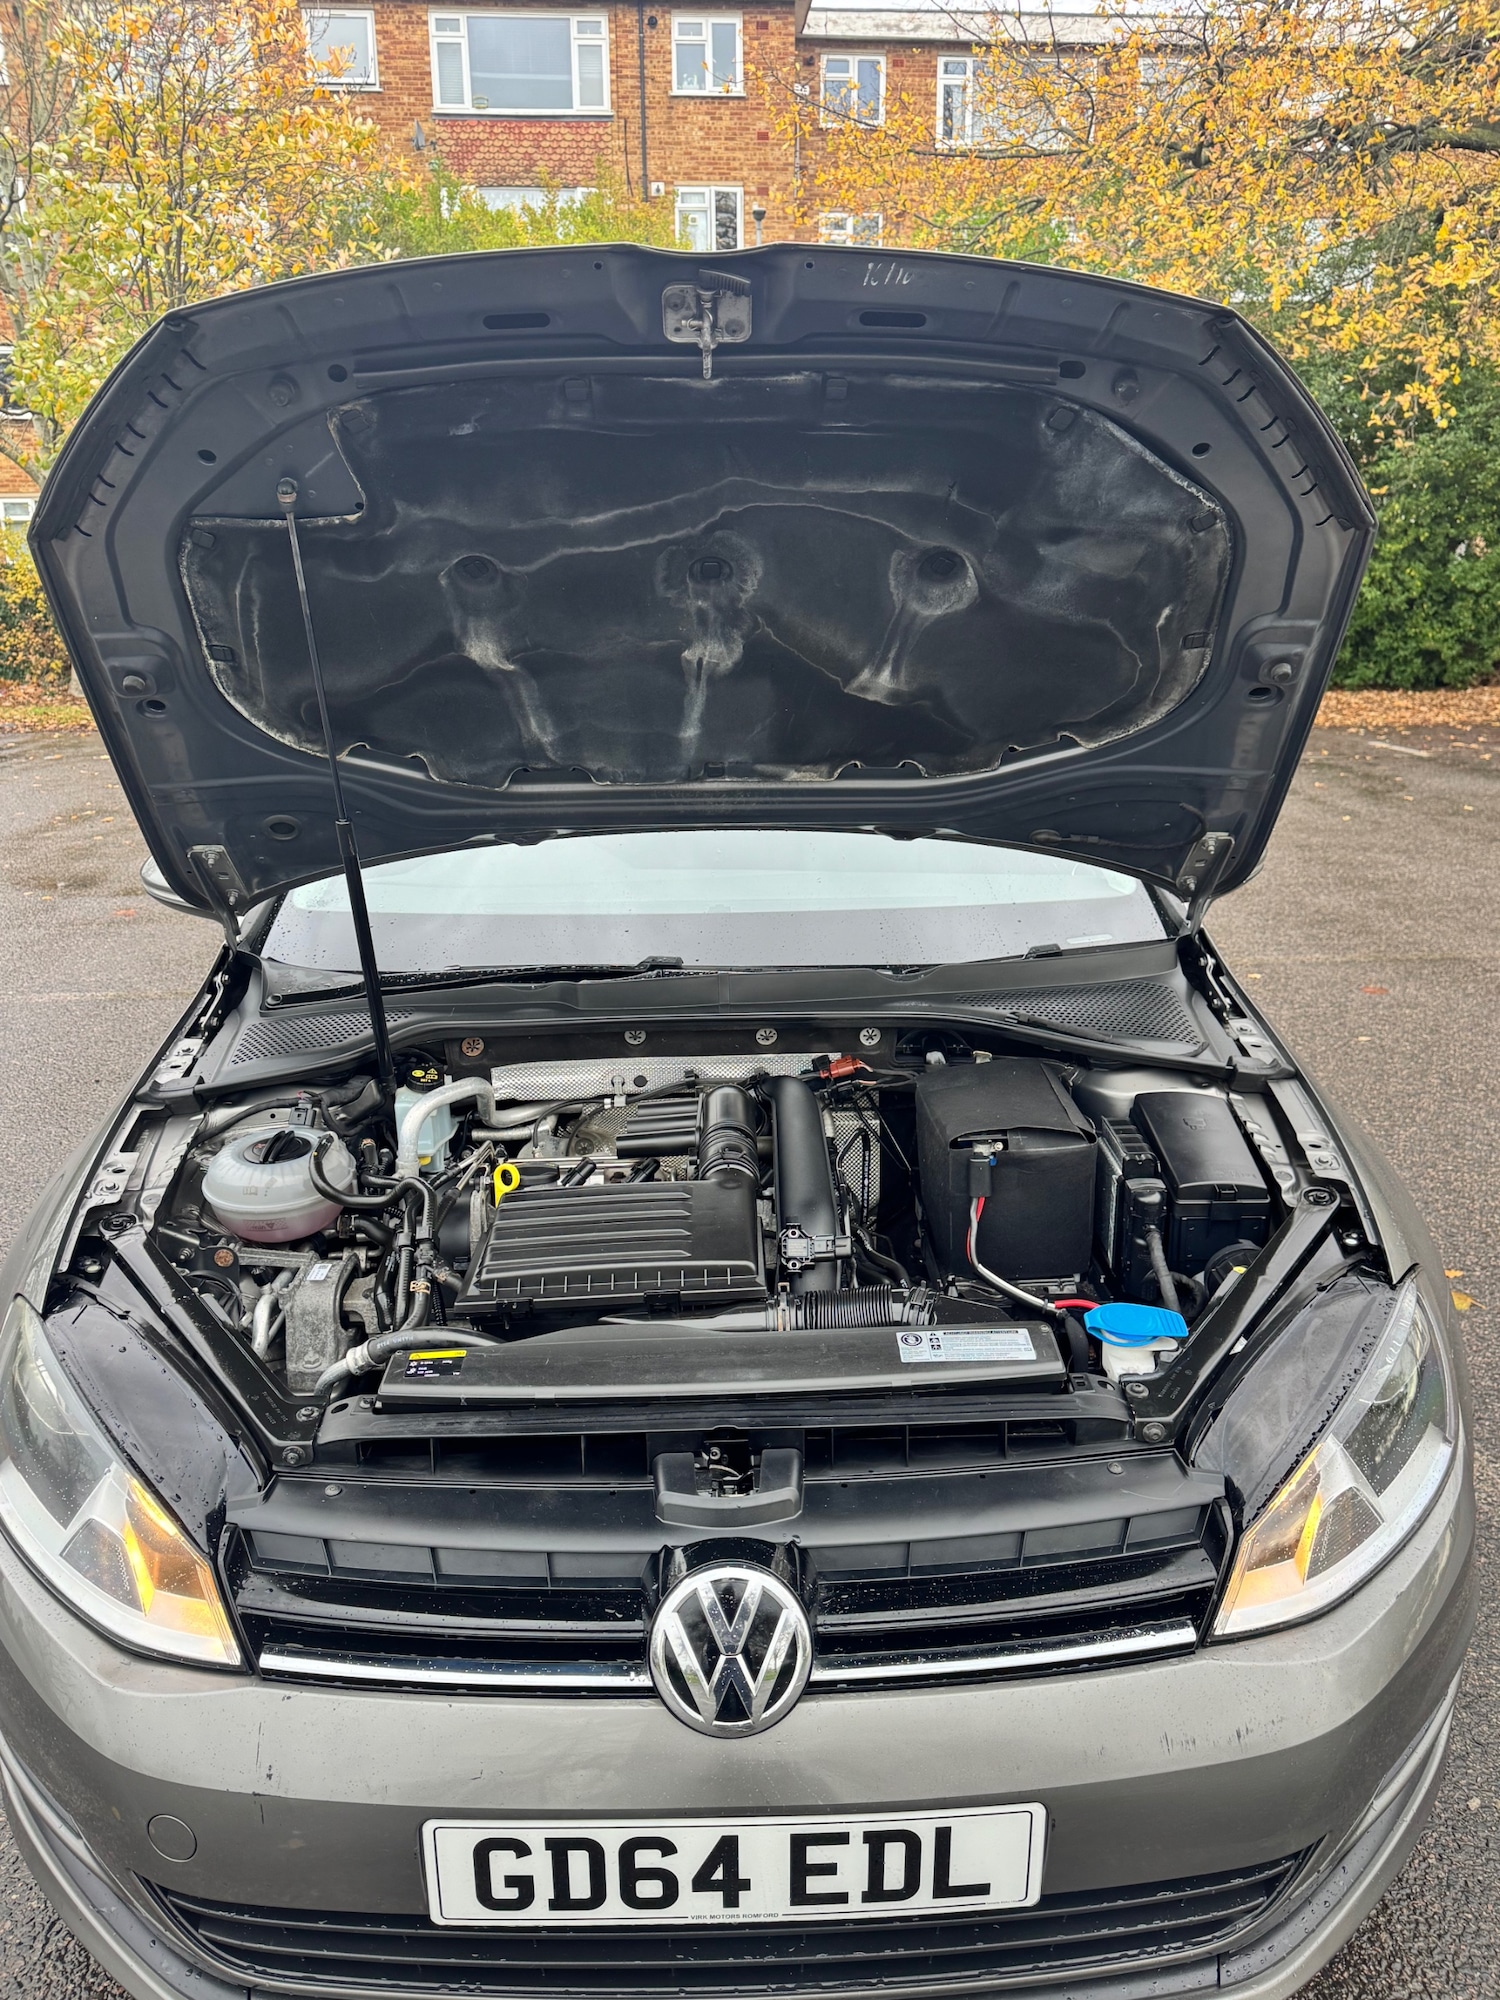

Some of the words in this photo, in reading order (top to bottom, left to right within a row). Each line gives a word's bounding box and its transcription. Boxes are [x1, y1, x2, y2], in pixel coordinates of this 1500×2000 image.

[657, 1570, 804, 1731] VW
[472, 1834, 751, 1912] GD64
[790, 1826, 991, 1907] EDL
